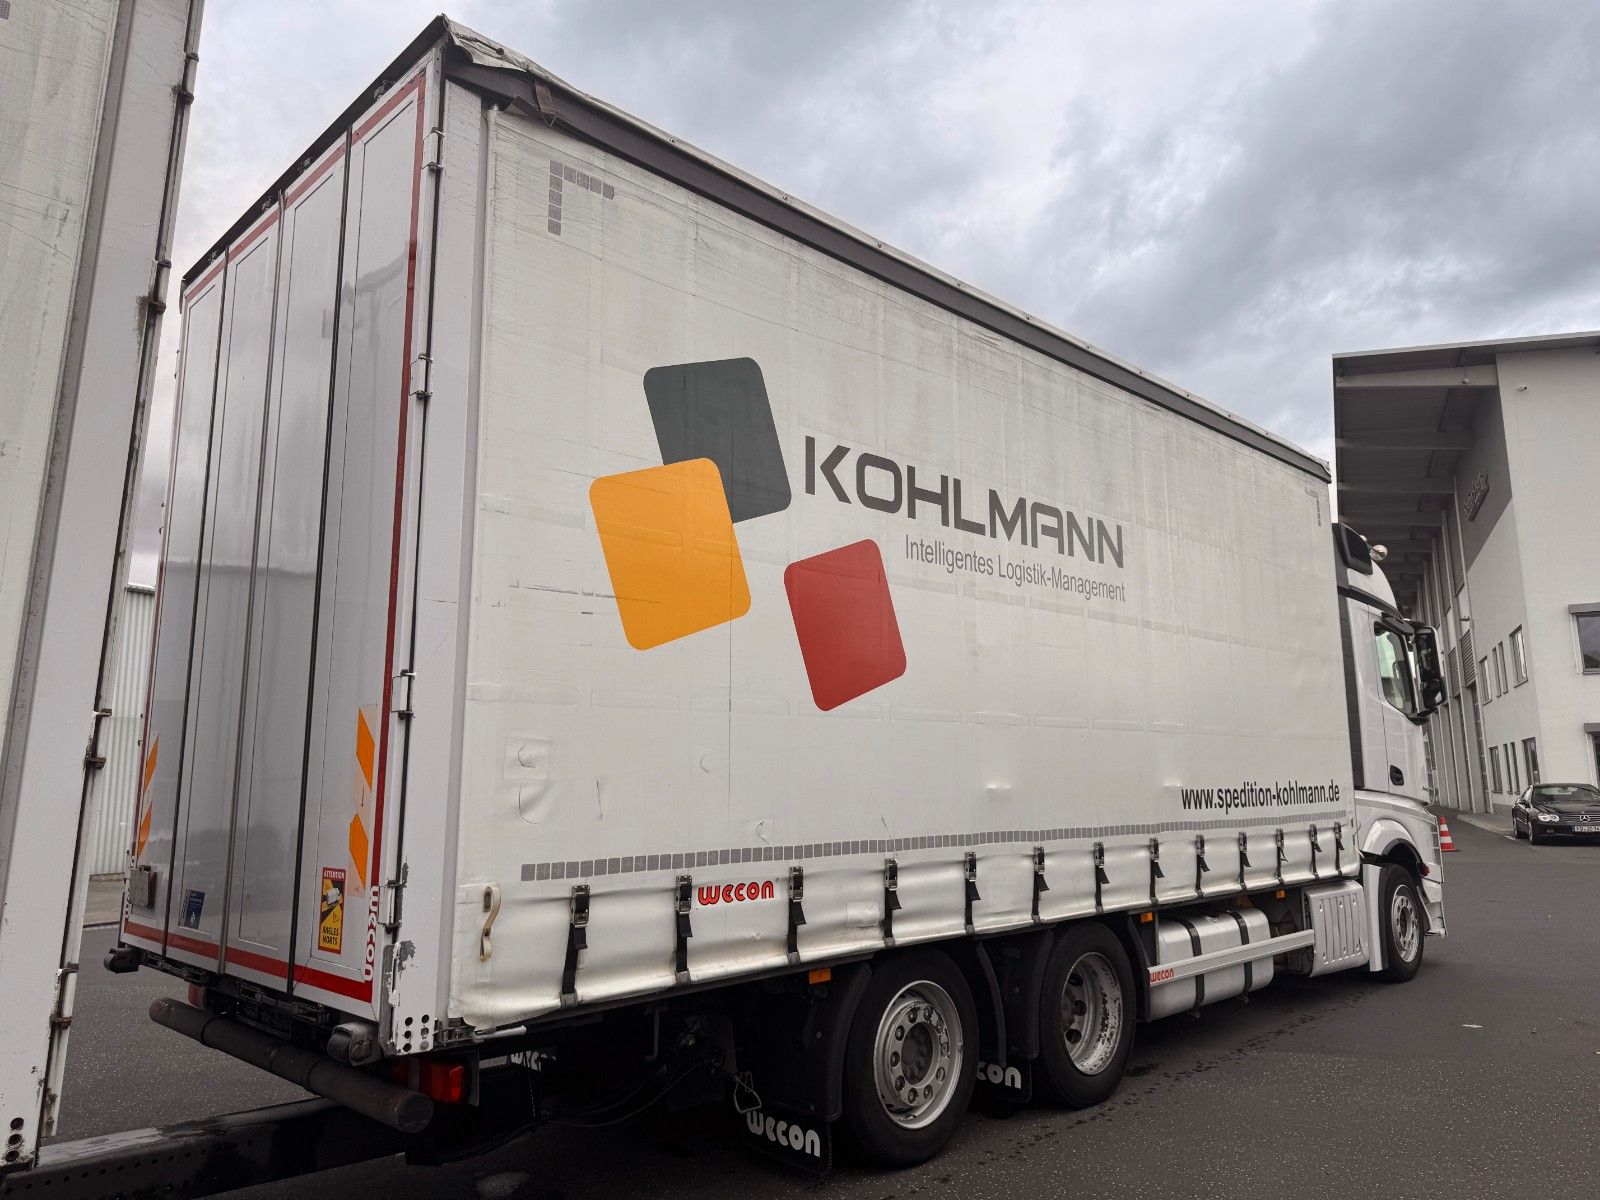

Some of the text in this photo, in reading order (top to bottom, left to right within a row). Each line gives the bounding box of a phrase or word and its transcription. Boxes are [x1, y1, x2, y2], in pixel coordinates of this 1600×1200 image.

[805, 435, 1124, 568] KOHLMANN
[905, 533, 1126, 602] Intelligentes Logistik-Management
[1181, 779, 1340, 815] www.spedition-kohlmann.de
[323, 869, 345, 880] ATTENTION
[697, 880, 774, 905] wecon
[321, 936, 338, 946] MORTS
[322, 926, 339, 937] ANGLES
[364, 885, 379, 981] wecon
[976, 1061, 1021, 1089] con
[746, 1109, 820, 1157] wecon
